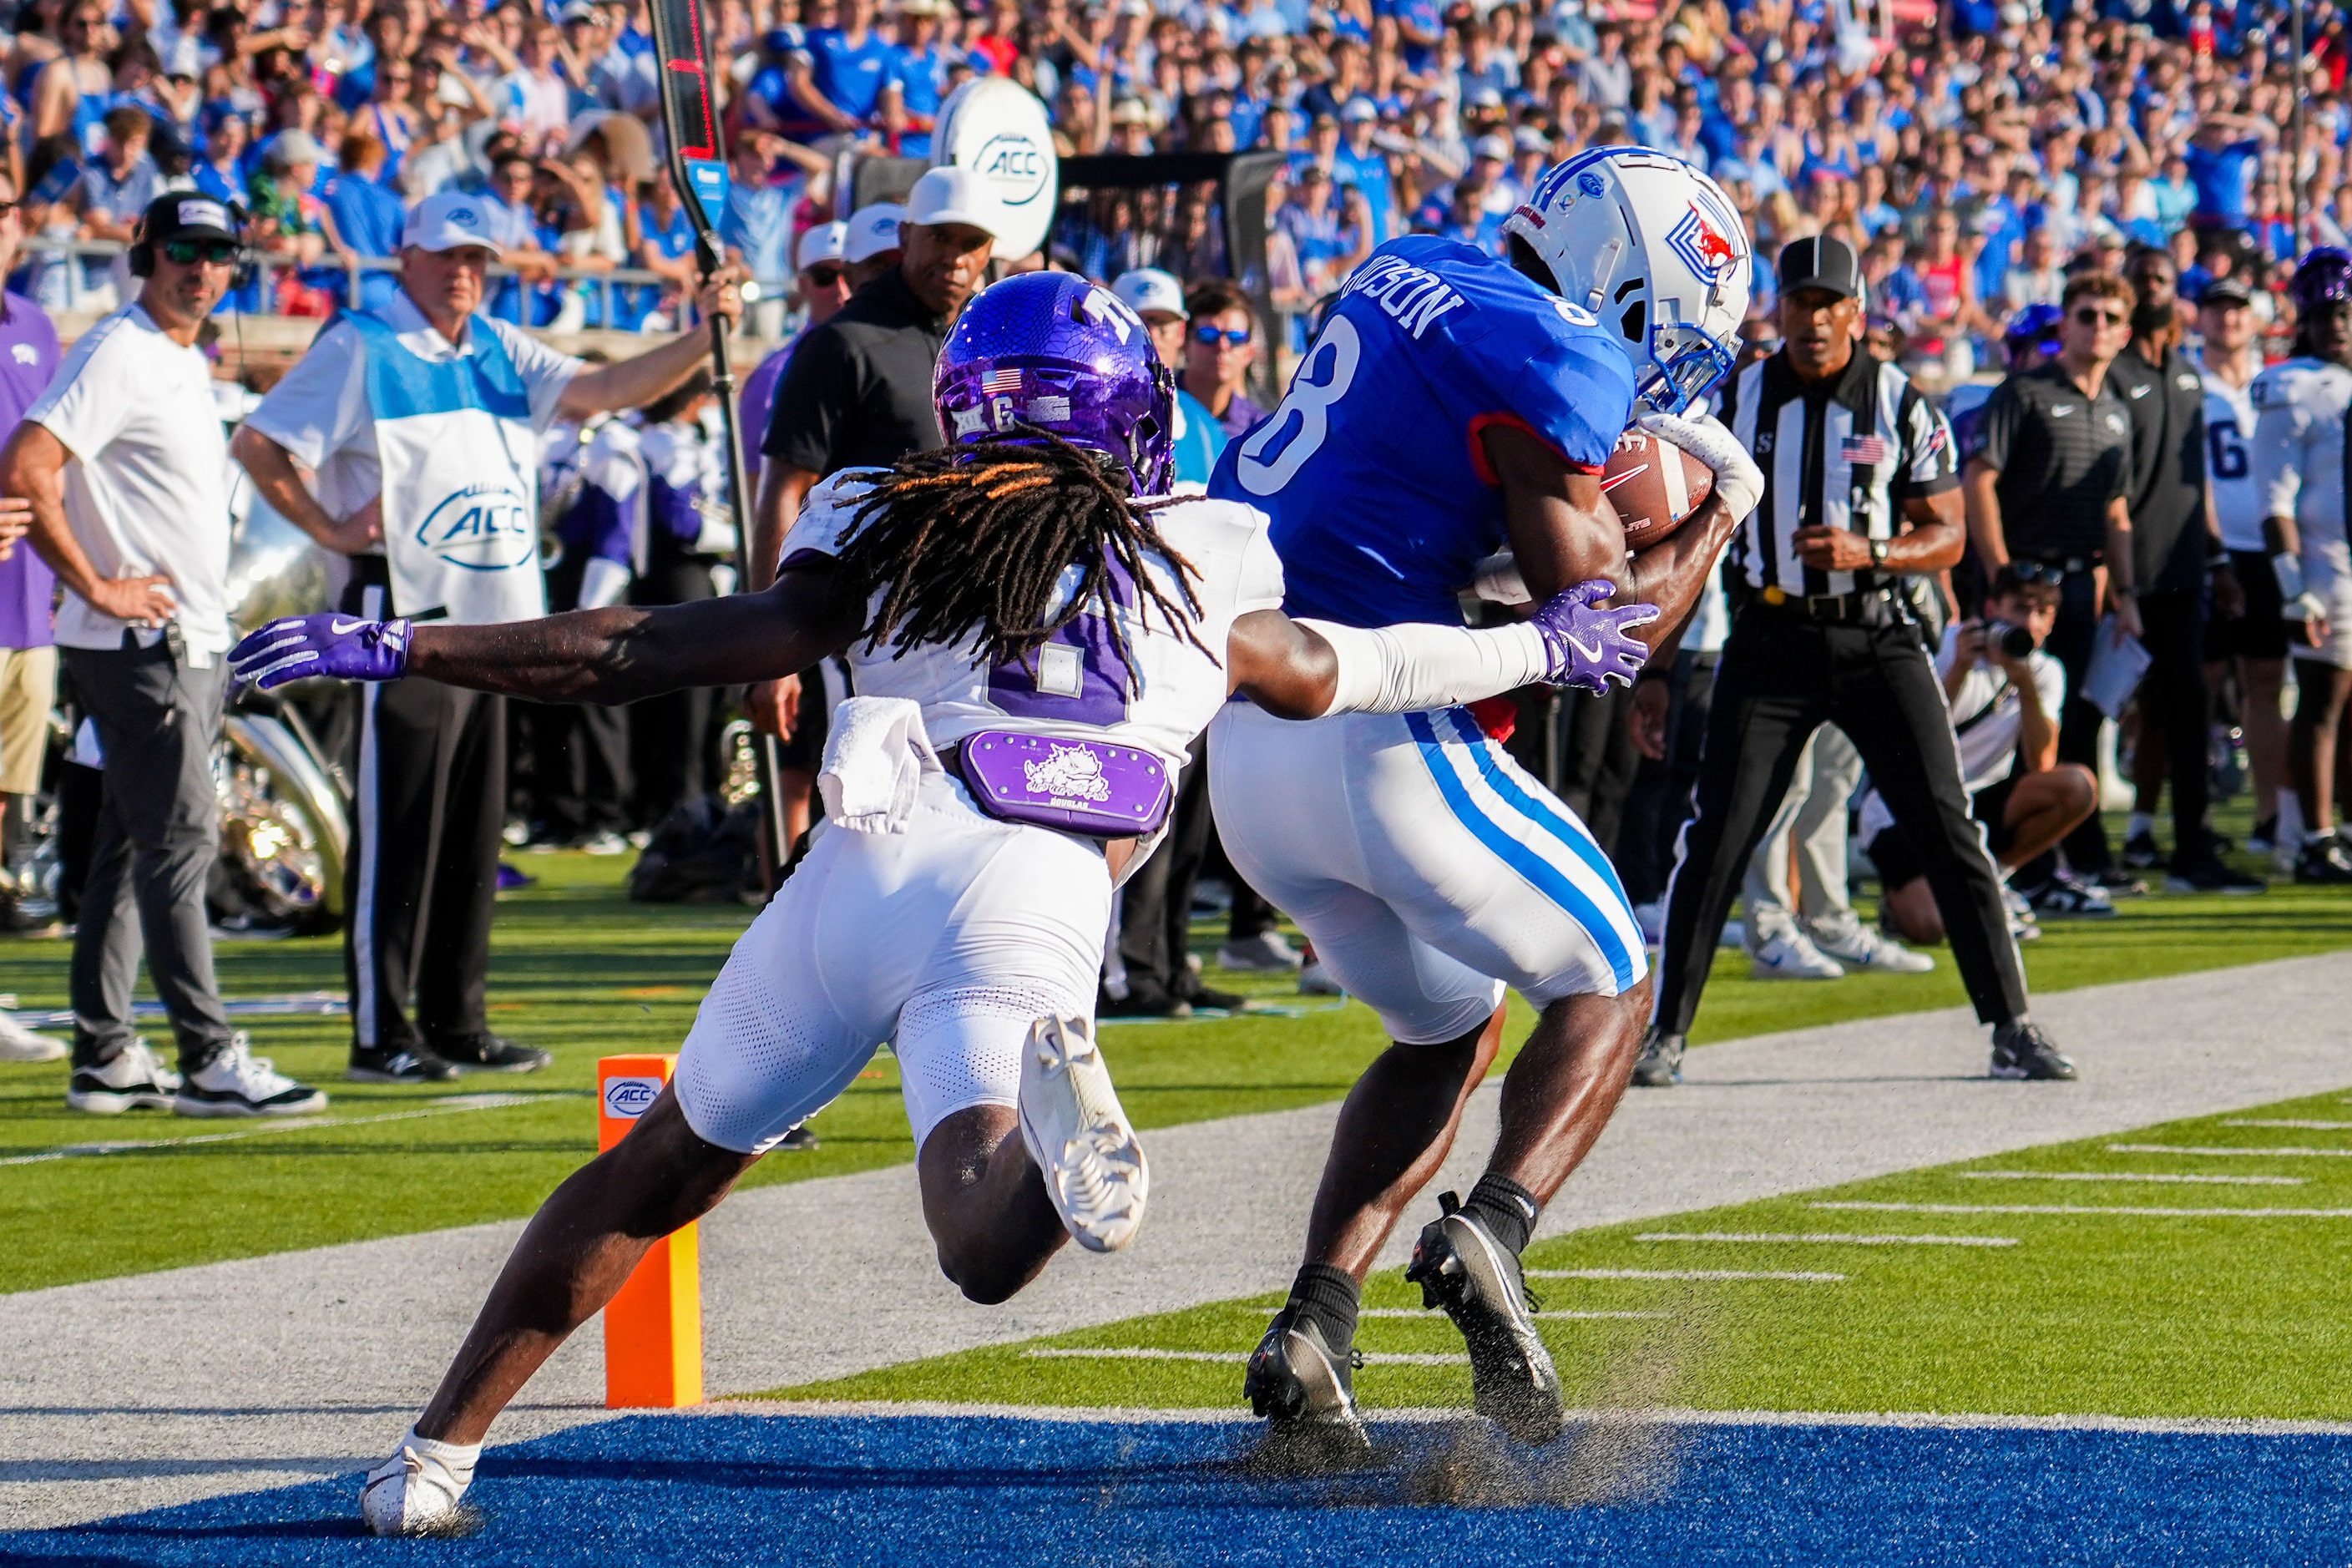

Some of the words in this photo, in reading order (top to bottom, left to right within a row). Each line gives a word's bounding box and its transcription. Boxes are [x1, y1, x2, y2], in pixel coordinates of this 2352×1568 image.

[987, 151, 1037, 175] ACC
[1237, 314, 1361, 496] 8
[1756, 432, 1774, 454] S
[2210, 420, 2248, 479] 6
[441, 506, 525, 541] ACC
[615, 1089, 651, 1101] ACC
